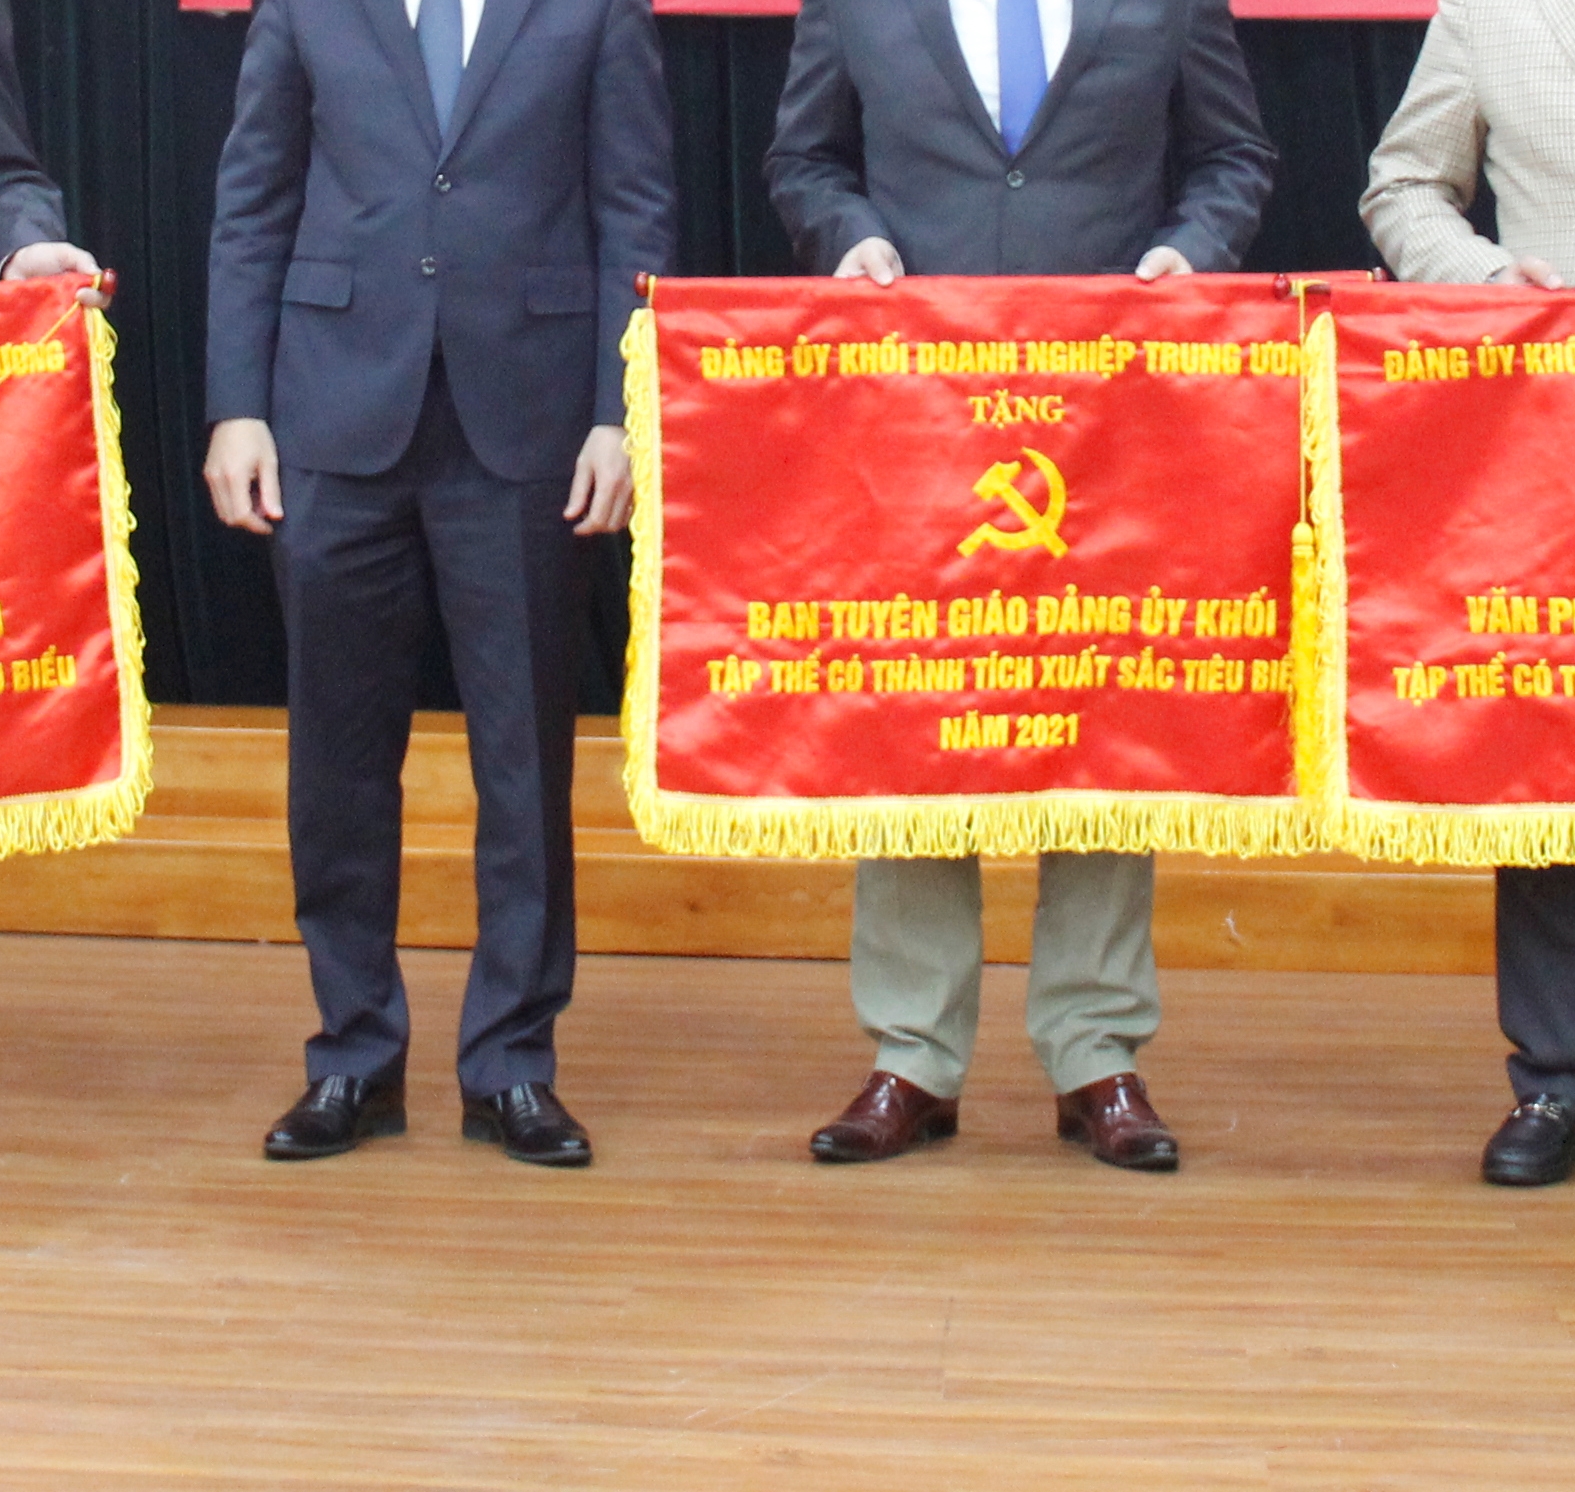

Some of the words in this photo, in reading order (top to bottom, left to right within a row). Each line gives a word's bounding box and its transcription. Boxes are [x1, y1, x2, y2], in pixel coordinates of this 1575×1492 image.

[701, 338, 786, 379] ĐẢNG
[792, 334, 831, 378] ỦY
[838, 331, 909, 377] KHỐI
[916, 340, 1019, 375] DOANH
[1026, 334, 1137, 380] NGHIỆP
[1142, 341, 1242, 375] TRUNG
[1384, 339, 1469, 382] ĐẢNG
[1477, 335, 1515, 377] ỦY
[968, 389, 1064, 427] TẶNG
[747, 601, 820, 640] BAN
[828, 592, 938, 640] TUYÊN
[947, 589, 1028, 639] GIÁO
[1035, 583, 1132, 636] ĐẢNG
[1140, 585, 1187, 637] ỦY
[1195, 585, 1277, 638] KHỐI
[1466, 586, 1538, 634] VĂN
[12, 644, 77, 693] BIỂU
[707, 654, 762, 700] TẬP
[769, 648, 821, 694] THỂ
[827, 653, 864, 693] CÓ
[871, 653, 965, 693] THÀNH
[972, 650, 1034, 690] TÍCH
[1039, 644, 1112, 689] XUẤT
[1117, 645, 1175, 692] SẮC
[1182, 652, 1245, 694] TIÊU
[1392, 660, 1446, 706] TẬP
[1453, 651, 1506, 698] THỂ
[1513, 658, 1553, 698] CÓ
[939, 709, 1010, 751] NĂM
[1015, 713, 1079, 748] 2021
